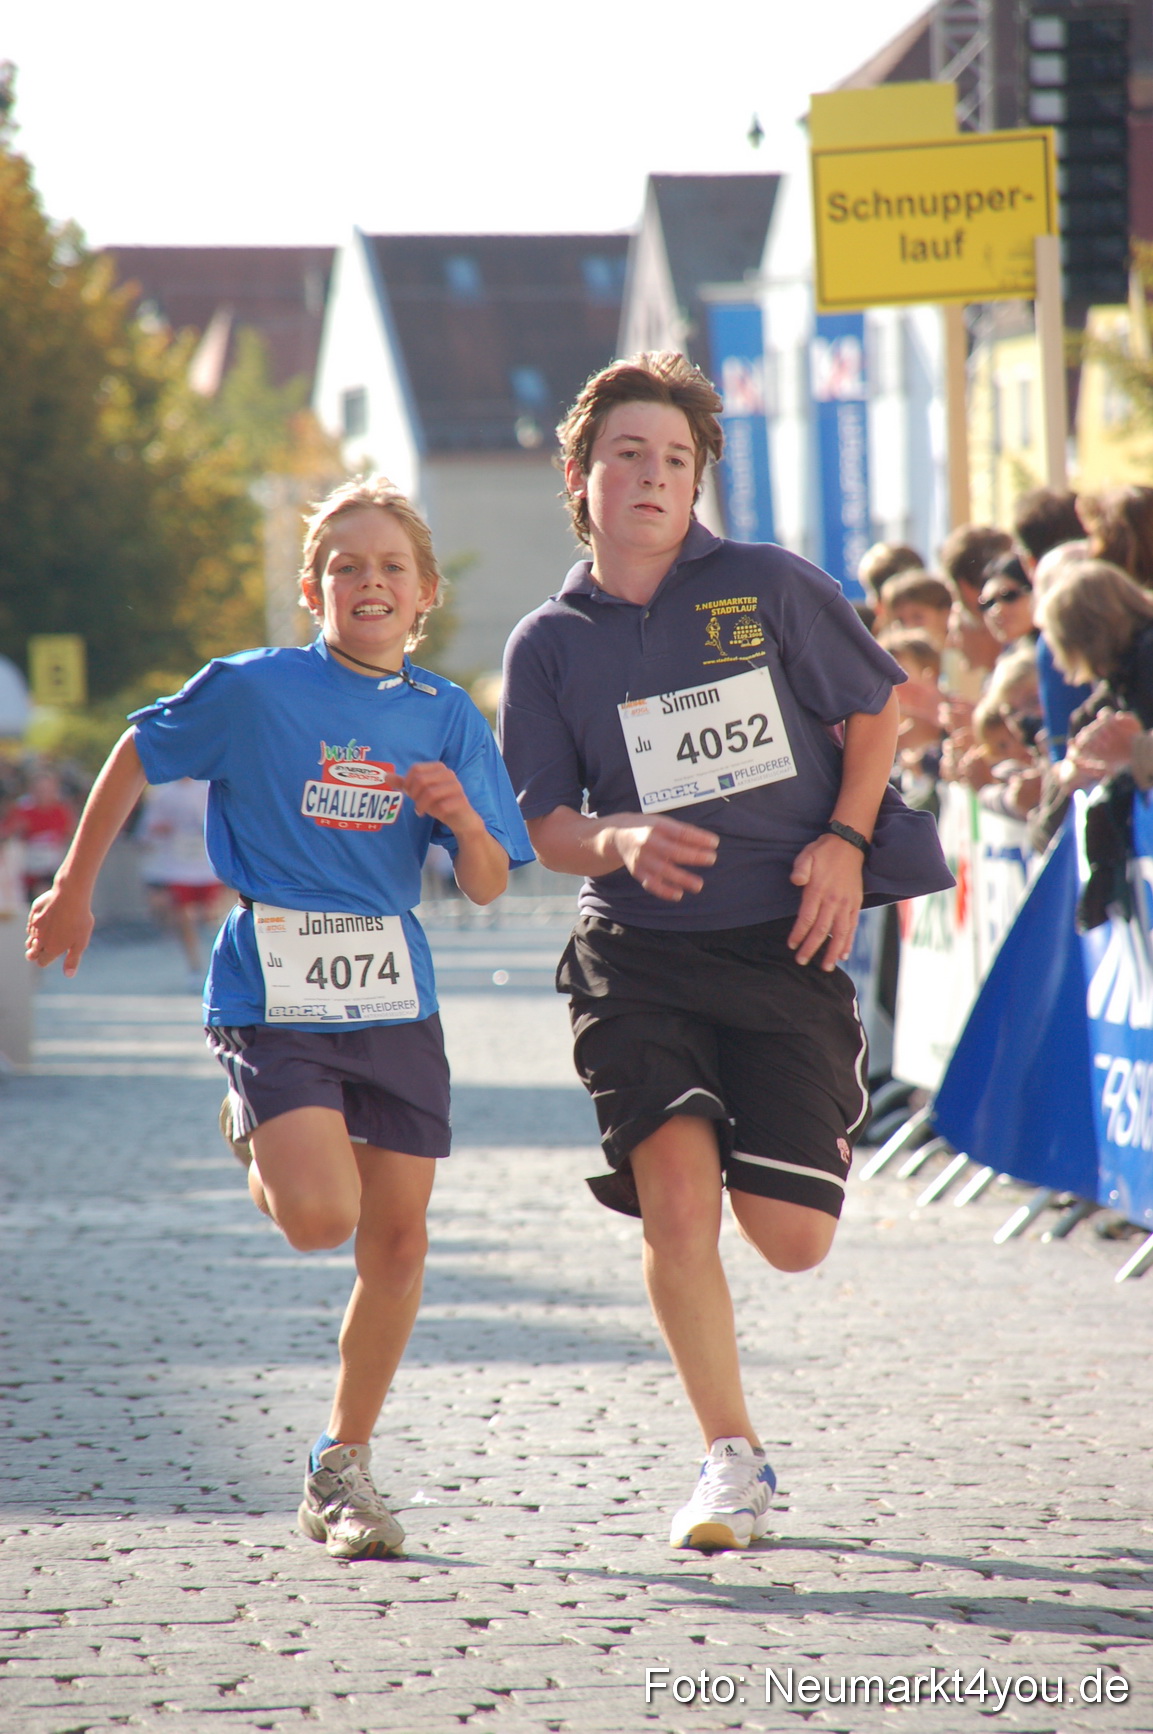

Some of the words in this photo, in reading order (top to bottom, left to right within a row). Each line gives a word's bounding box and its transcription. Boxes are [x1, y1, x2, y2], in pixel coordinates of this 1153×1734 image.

[827, 186, 1035, 222] Schnupper-
[900, 228, 965, 262] lauf
[702, 597, 758, 610] NEUMARKTER
[711, 604, 757, 616] STADTLAUF
[660, 688, 720, 715] Simon
[635, 736, 652, 753] Ju
[676, 713, 774, 764] 4052
[734, 756, 791, 780] PFLEIDERER
[305, 784, 400, 821] CHALLENGE
[643, 782, 699, 805] BOCK
[320, 818, 378, 830] ROTH
[298, 912, 384, 936] Johannes
[267, 952, 283, 968] Ju
[305, 951, 400, 990] 4074
[269, 1005, 327, 1016] BOCK
[360, 1000, 417, 1014] PFLEIDERER
